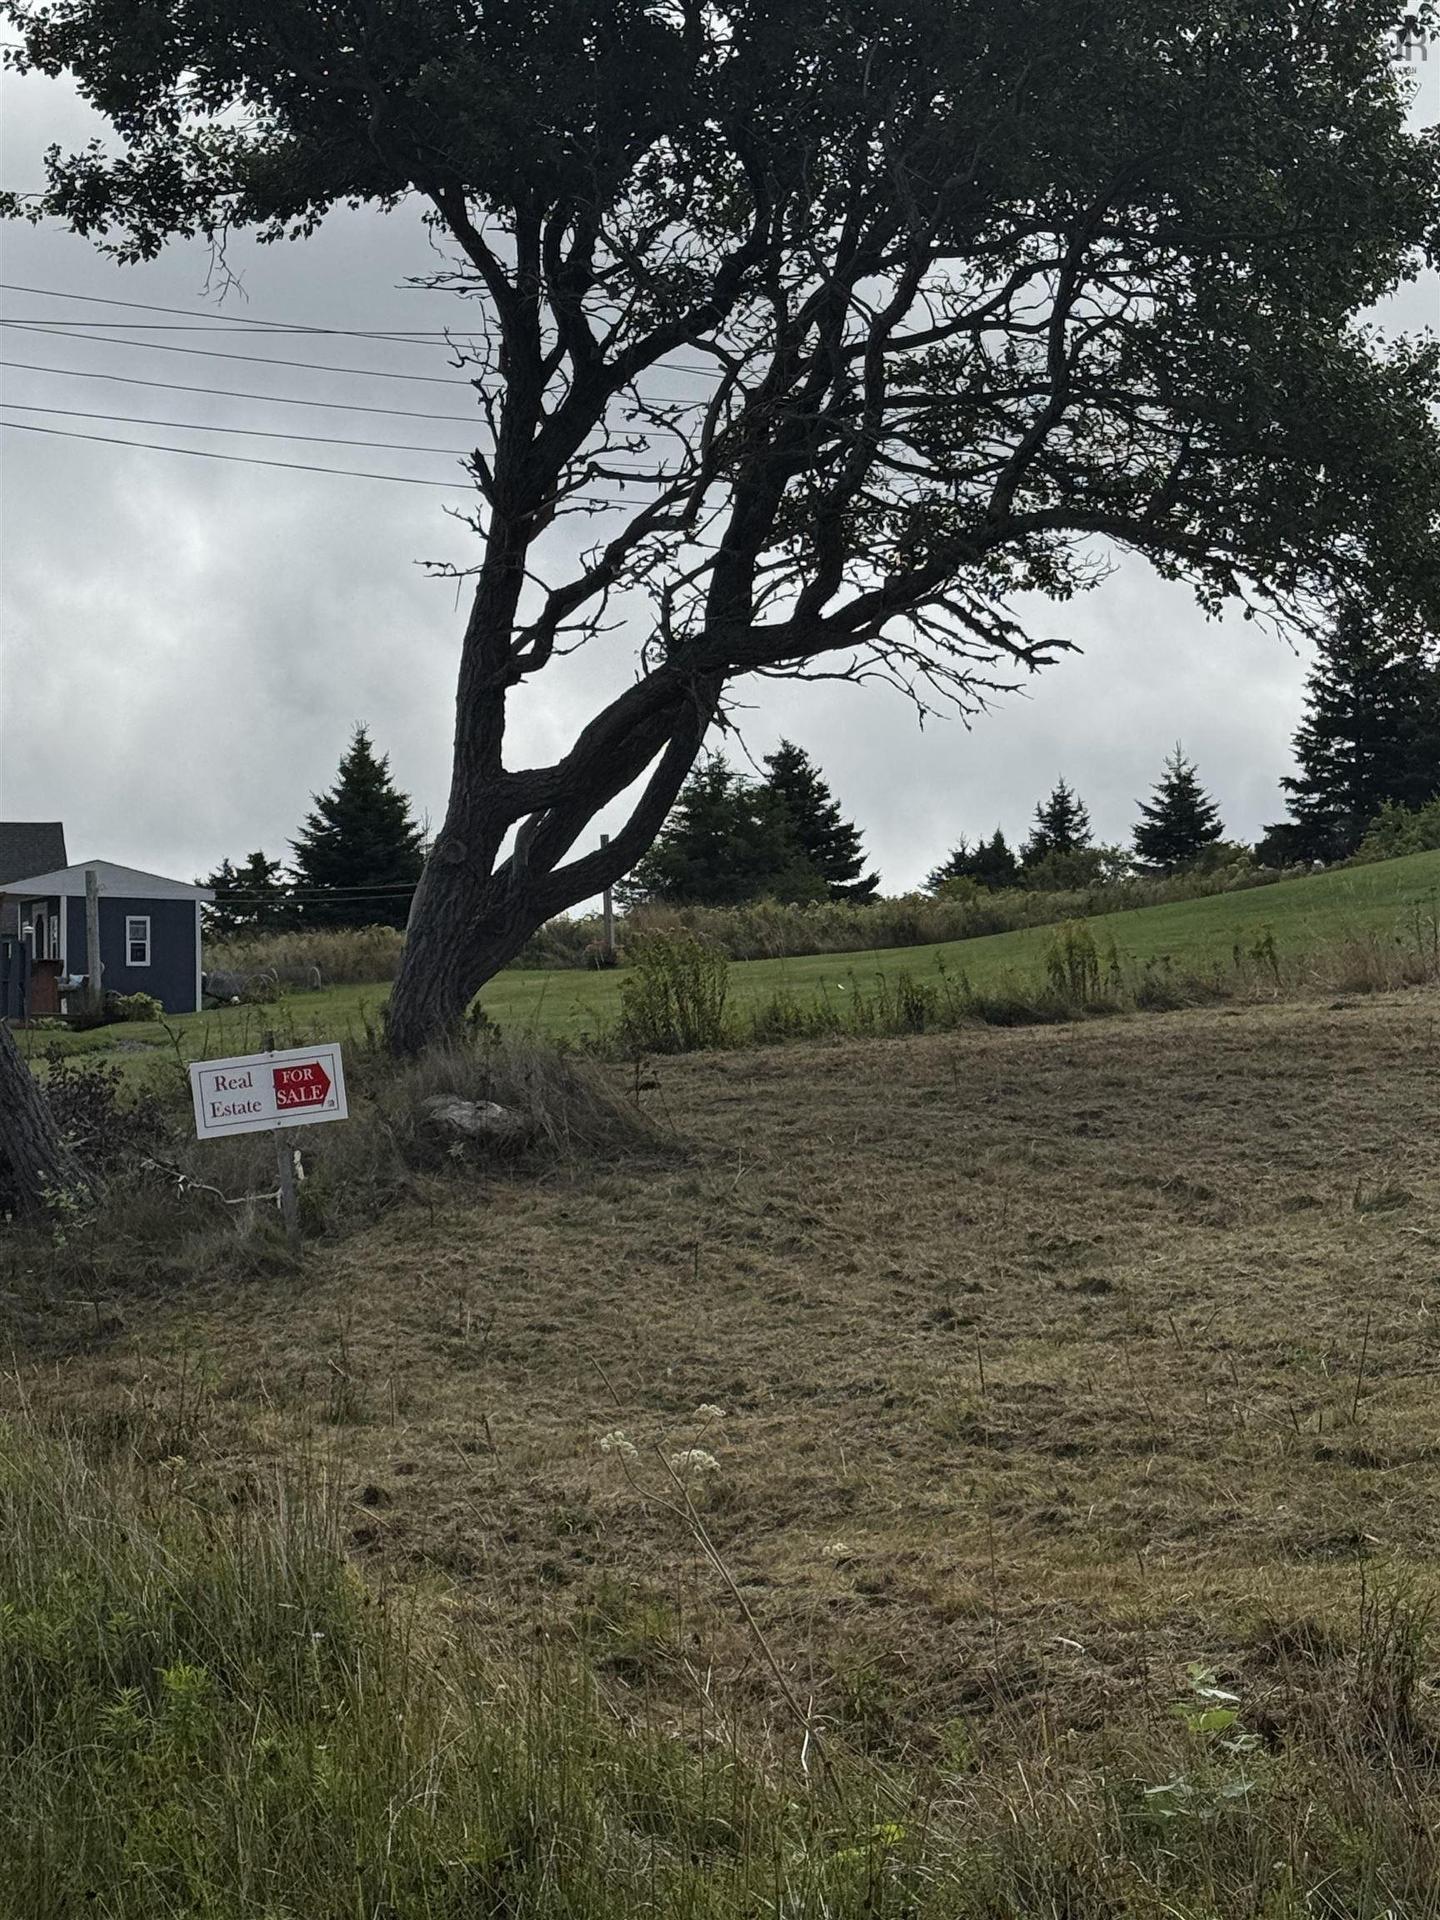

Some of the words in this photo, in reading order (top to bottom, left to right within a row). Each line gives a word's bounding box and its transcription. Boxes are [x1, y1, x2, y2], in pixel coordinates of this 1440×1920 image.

[214, 1071, 253, 1092] Real
[282, 1068, 314, 1084] FOR
[277, 1085, 324, 1105] SALE
[210, 1100, 262, 1118] Estate
